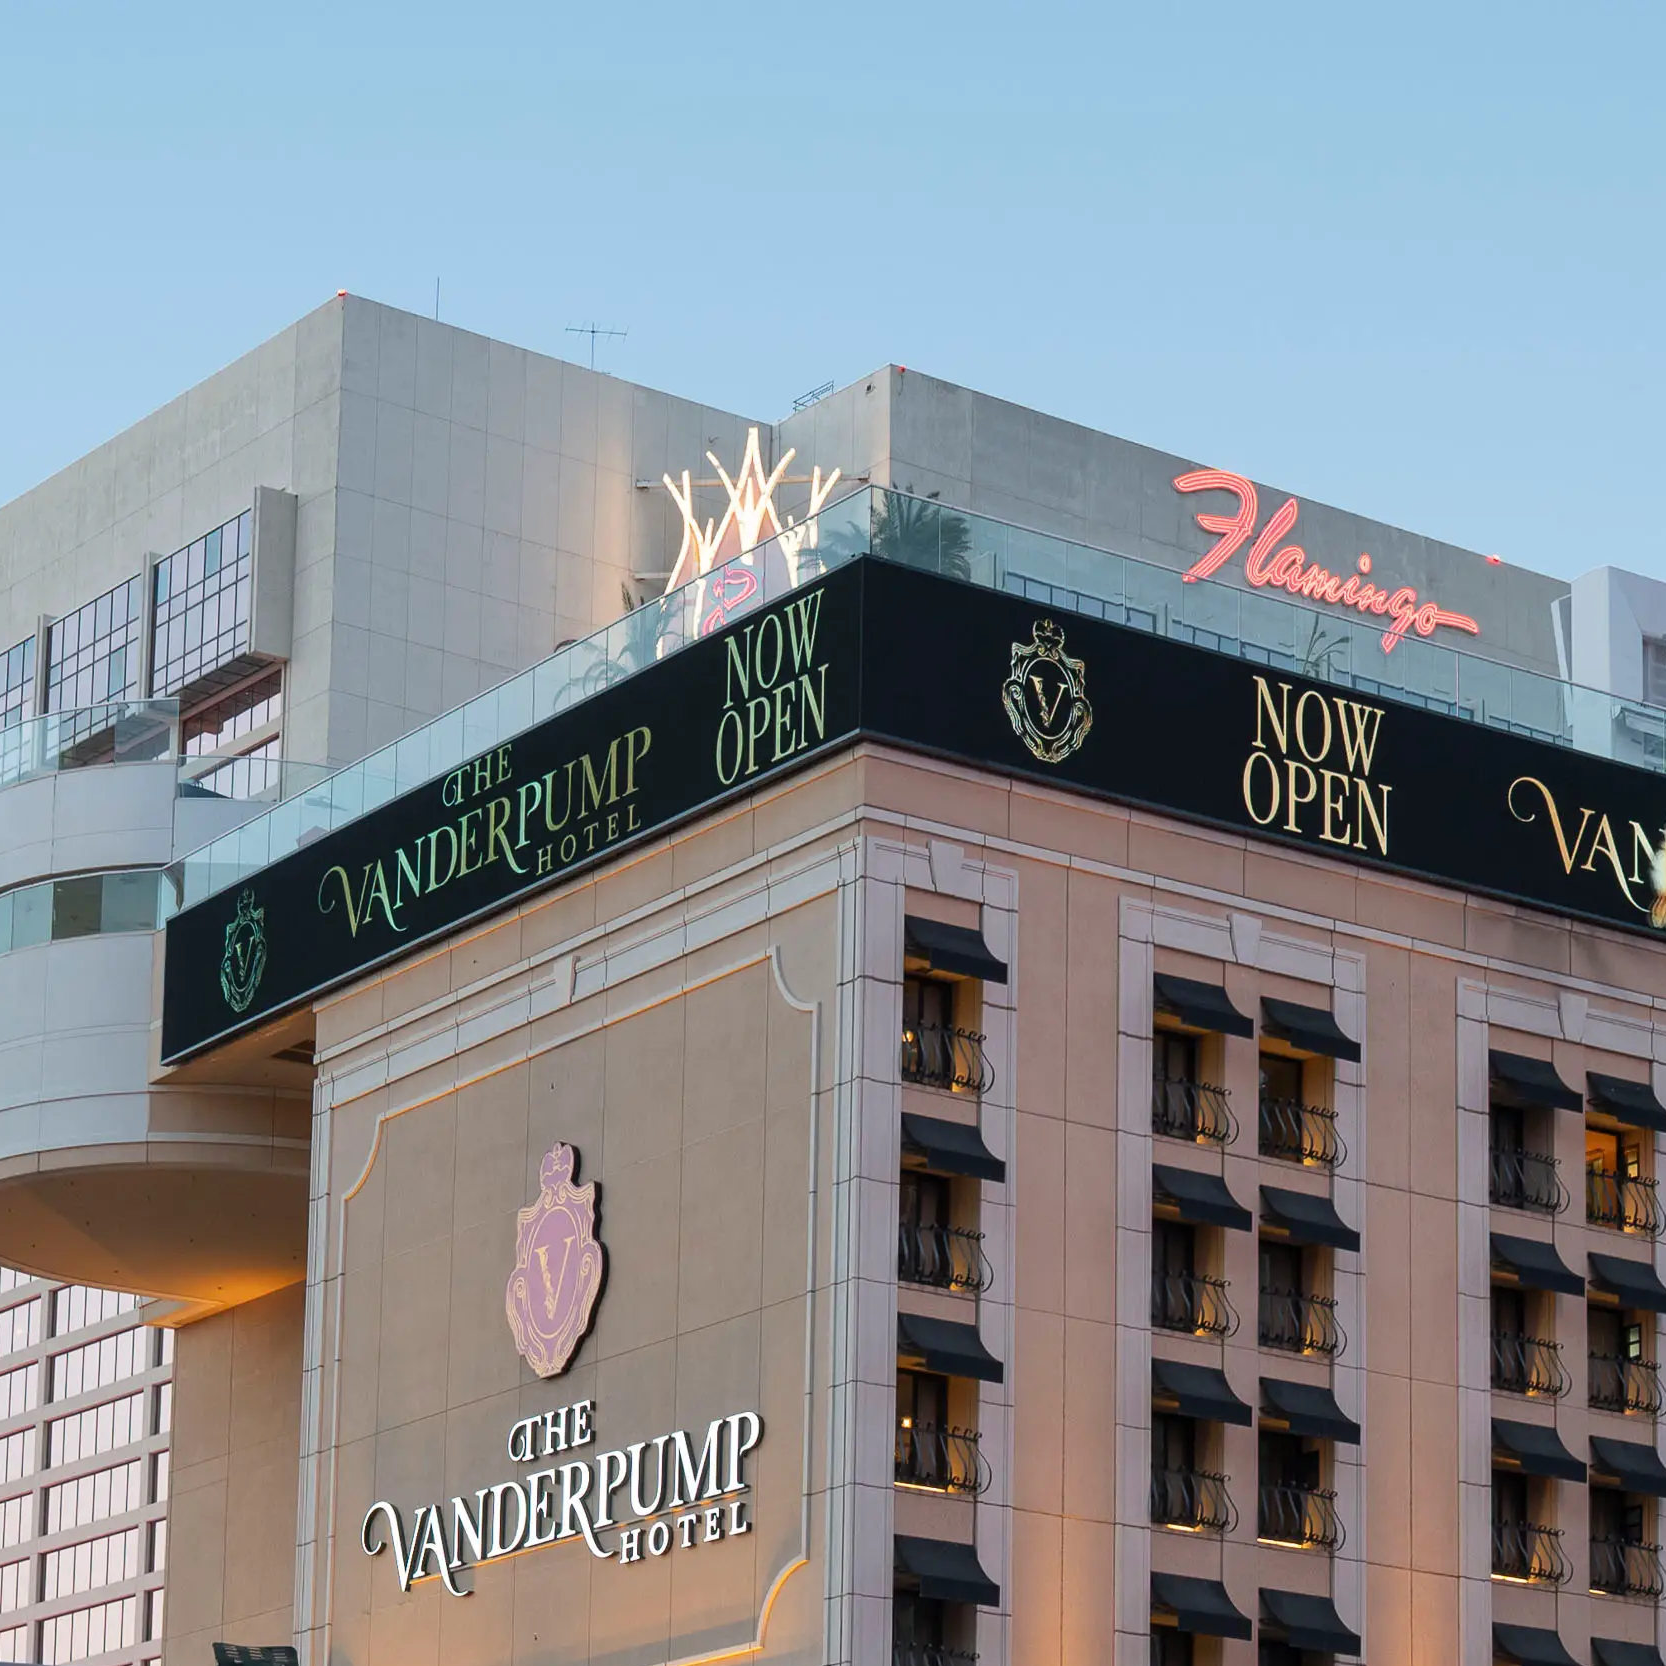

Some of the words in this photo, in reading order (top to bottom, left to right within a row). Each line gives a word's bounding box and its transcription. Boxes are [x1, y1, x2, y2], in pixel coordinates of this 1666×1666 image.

[1173, 469, 1479, 654] Flamingo
[723, 588, 825, 709] NOW
[442, 743, 514, 807] THE
[715, 663, 829, 786] OPEN
[1251, 675, 1385, 776] NOW
[318, 725, 653, 938] VANDERPUMP
[536, 803, 642, 876] HOTEL
[1243, 751, 1393, 856] OPEN
[507, 1399, 596, 1463] THE
[361, 1410, 764, 1598] VANDERPUMP
[620, 1502, 753, 1565] HOTEL
